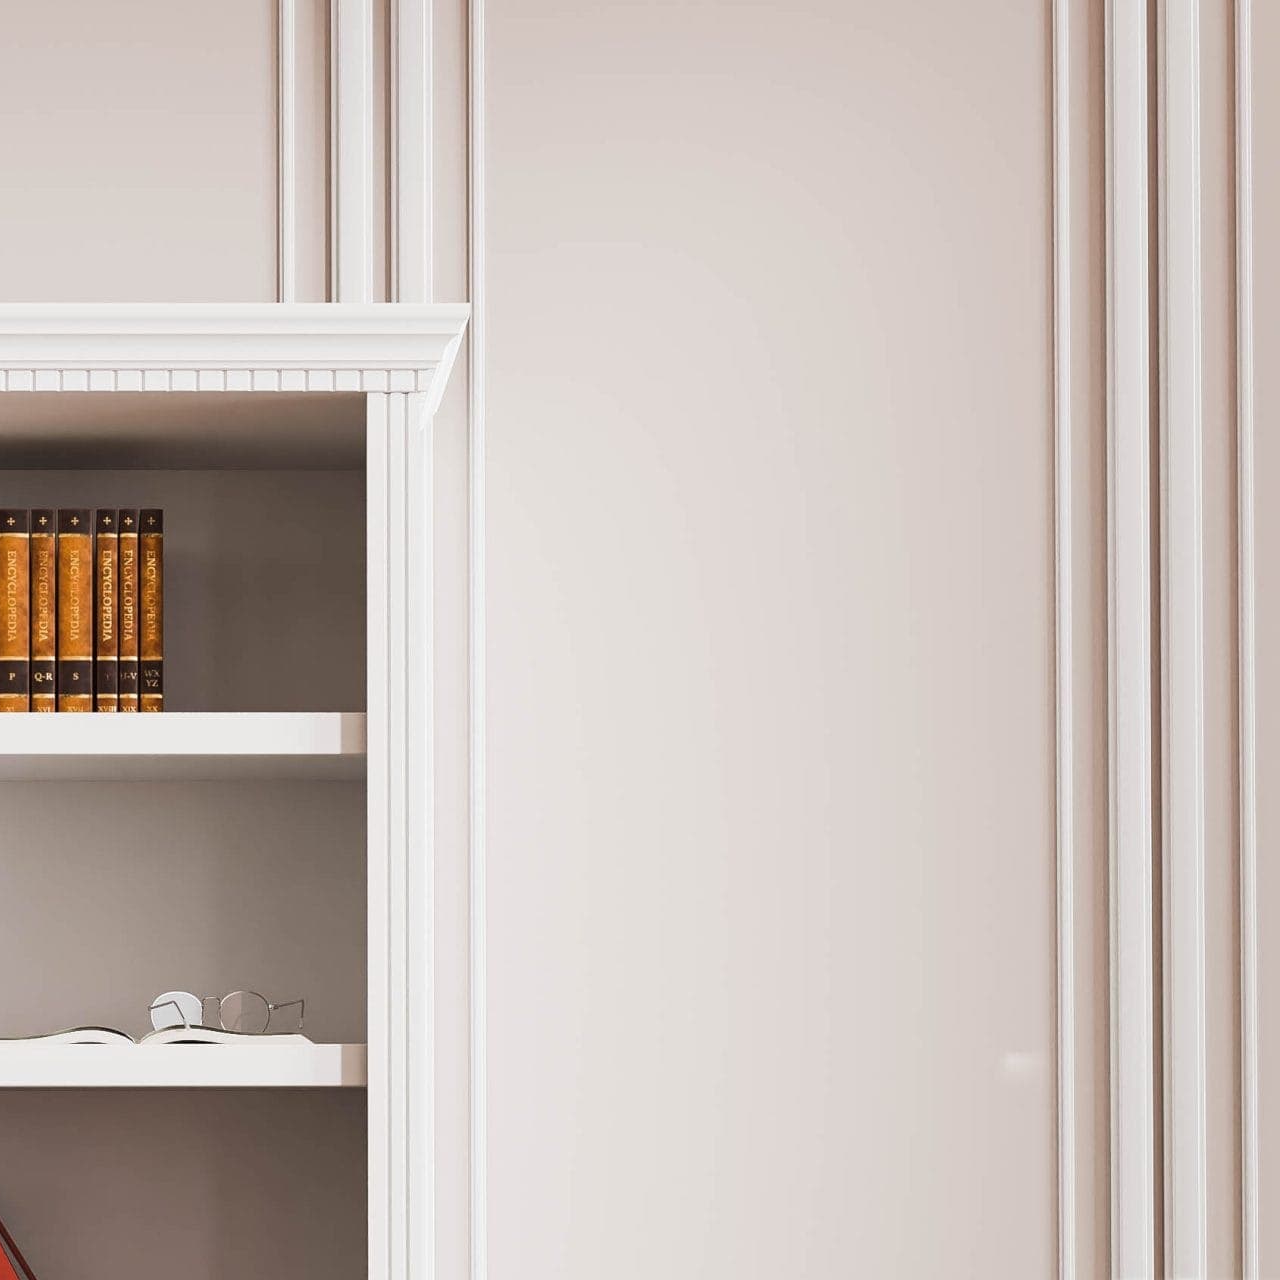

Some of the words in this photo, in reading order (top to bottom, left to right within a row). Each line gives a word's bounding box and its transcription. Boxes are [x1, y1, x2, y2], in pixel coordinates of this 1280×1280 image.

[7, 550, 16, 641] ENCYCLOPEDIA
[39, 550, 48, 642] ENCYCLOPEDIA
[70, 550, 79, 640] ENCYCLOPEDIA
[103, 550, 112, 641] ENCYCLOPEDIA
[124, 550, 133, 640] ENCYCLOPEDIA
[34, 672, 53, 682] Q-R
[72, 672, 79, 681] S
[146, 679, 159, 687] YZ
